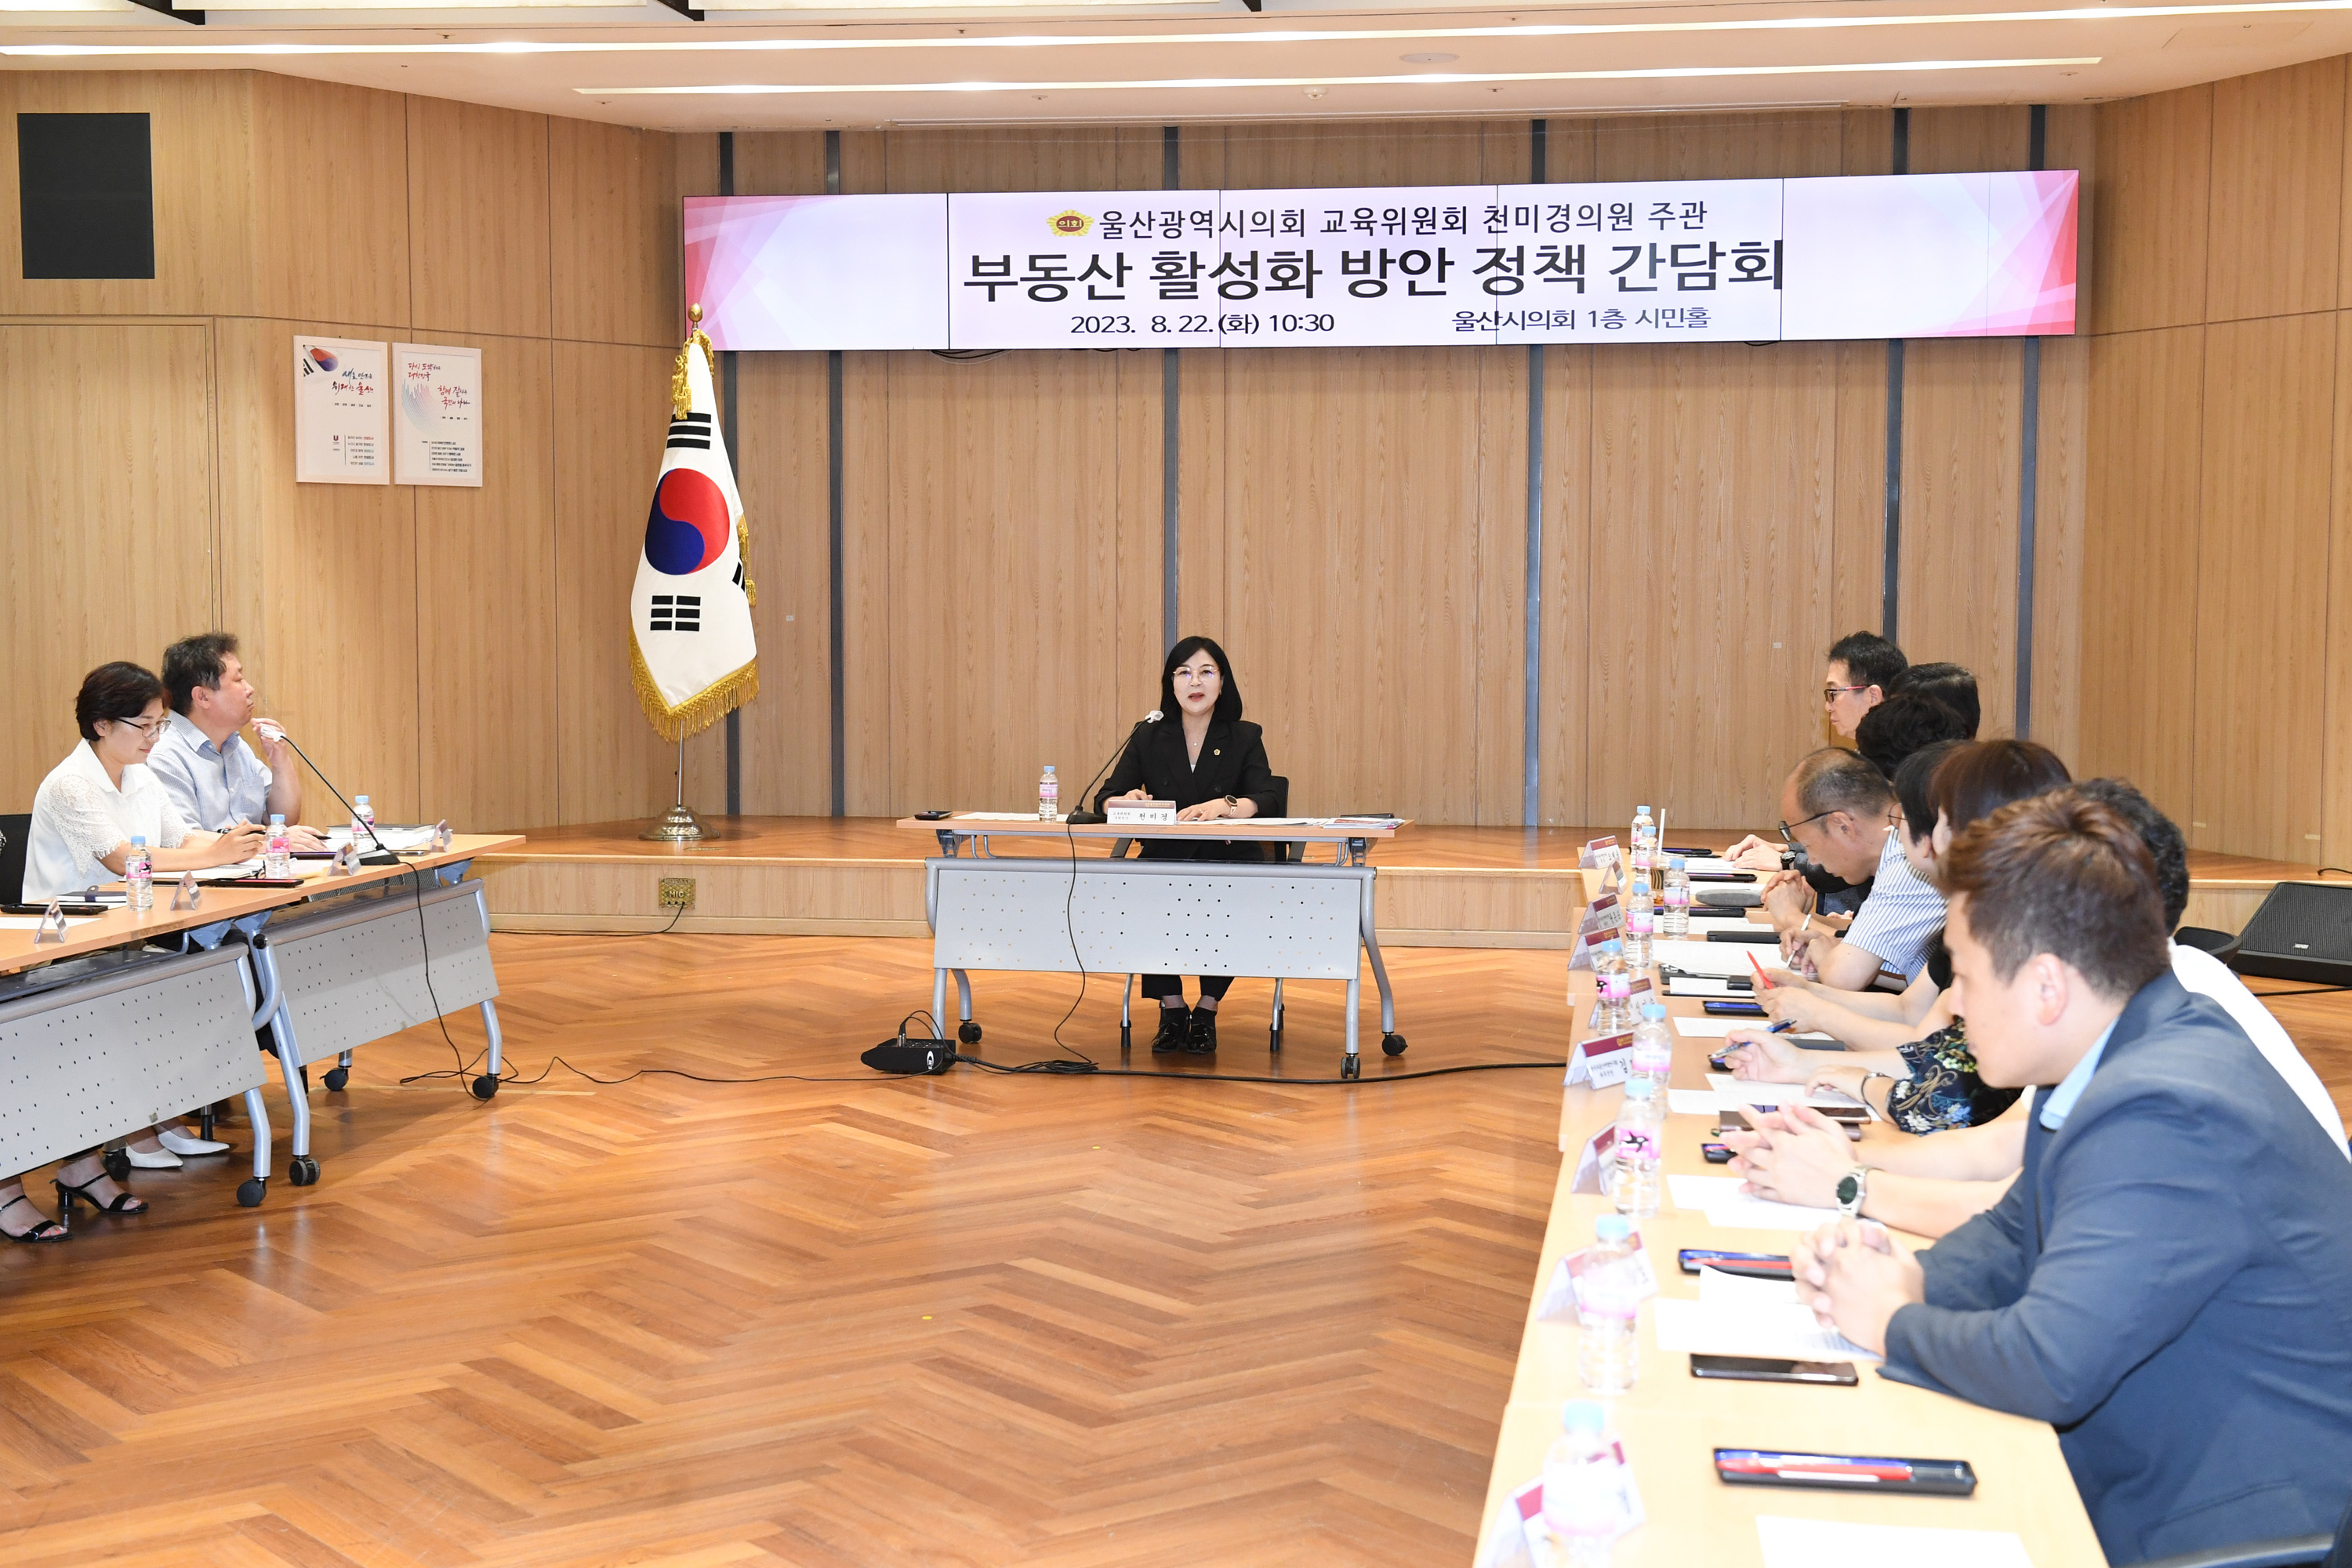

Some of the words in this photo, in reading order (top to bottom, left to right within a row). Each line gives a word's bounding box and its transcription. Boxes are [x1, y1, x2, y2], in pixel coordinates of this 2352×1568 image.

[1099, 209, 1305, 240] 울산광역시의회
[1319, 205, 1467, 237] 교육위원회
[1483, 202, 1633, 234] 천미경의원
[1648, 201, 1708, 230] 주관
[964, 252, 1133, 303] 부동산
[1149, 249, 1323, 300] 활성화
[1341, 247, 1455, 299] 방안
[1472, 244, 1585, 296] 정책
[1608, 239, 1782, 292] 간담회
[1070, 315, 1136, 334] 2023.
[1269, 314, 1334, 332] 10:30
[1451, 309, 1575, 332] 울산시의회
[1588, 308, 1627, 330] 1층
[1635, 307, 1711, 328] 시민홀
